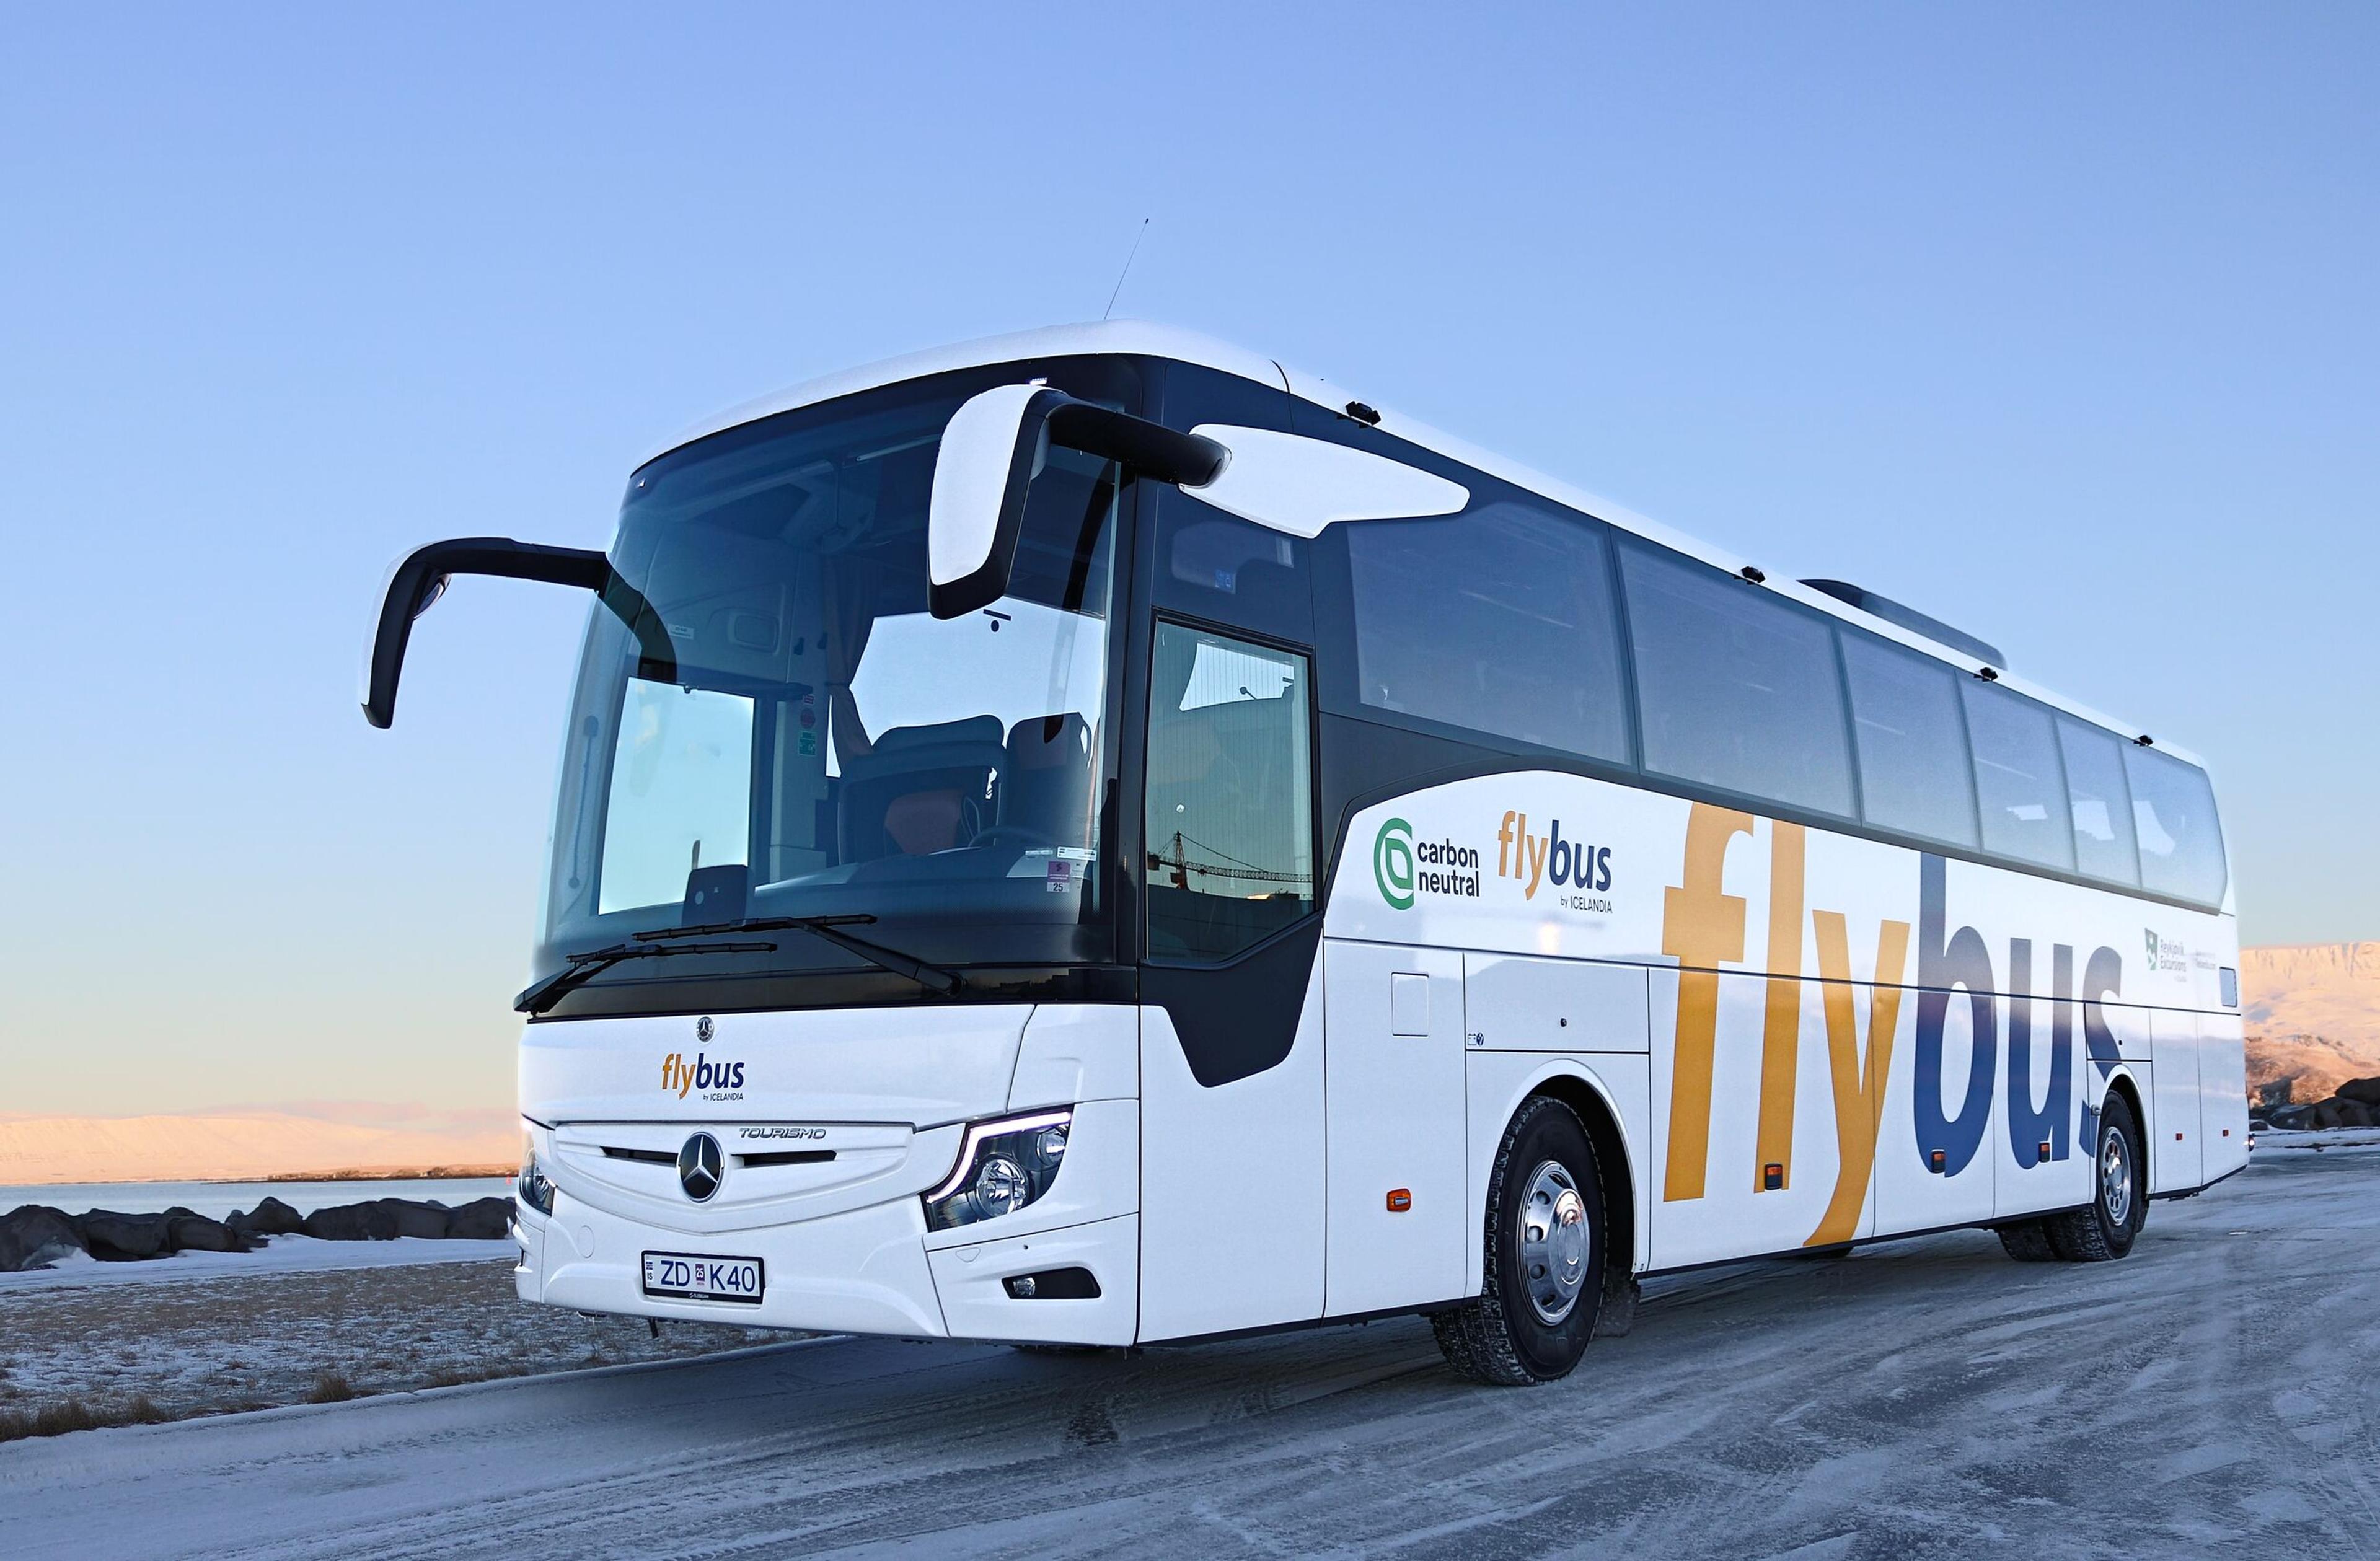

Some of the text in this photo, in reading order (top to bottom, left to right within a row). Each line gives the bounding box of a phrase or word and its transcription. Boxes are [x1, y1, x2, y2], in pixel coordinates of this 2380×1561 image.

[1417, 838, 1479, 868] carbon
[1498, 810, 1611, 900] flybus
[1053, 883, 1064, 892] 25
[1419, 869, 1479, 897] neutral
[1561, 895, 1613, 913] by ICELANDIA
[1662, 801, 2122, 1247] flybus
[661, 1053, 745, 1100] flybus
[710, 1093, 744, 1101] ICELANDIA
[739, 1127, 827, 1140] TOURISMO
[647, 1272, 653, 1280] IS
[660, 1260, 756, 1293] ZD K40
[696, 1267, 704, 1278] 25
